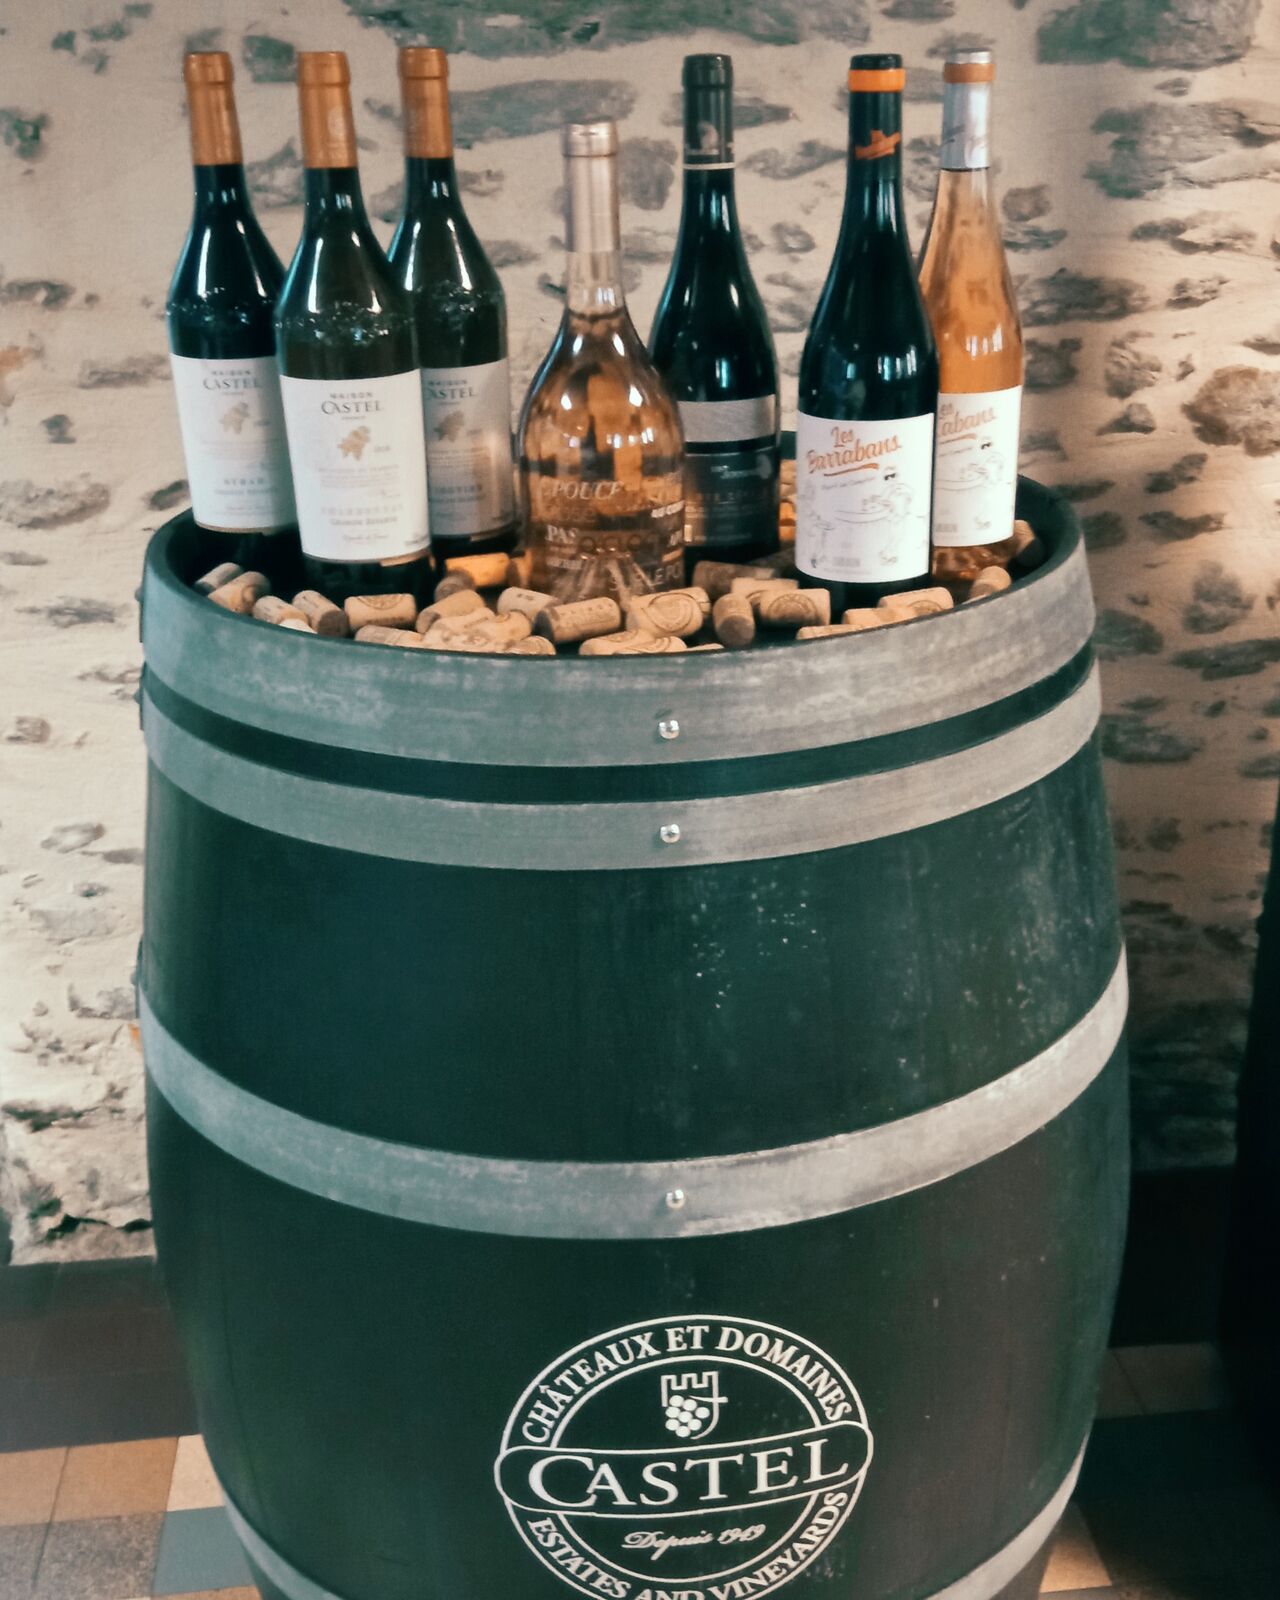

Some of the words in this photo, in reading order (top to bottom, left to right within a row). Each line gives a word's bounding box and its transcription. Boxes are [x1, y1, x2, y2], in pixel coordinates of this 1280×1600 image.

[320, 400, 384, 415] CASTEL
[521, 1333, 661, 1444] CHÂTEAUX
[665, 1325, 711, 1352] ET
[718, 1327, 853, 1422] DOMAINES
[528, 1439, 849, 1509] CASTEL
[527, 1517, 632, 1600] ESTATES
[708, 1491, 849, 1600] VINEYARDS
[621, 1529, 714, 1561] Depuis
